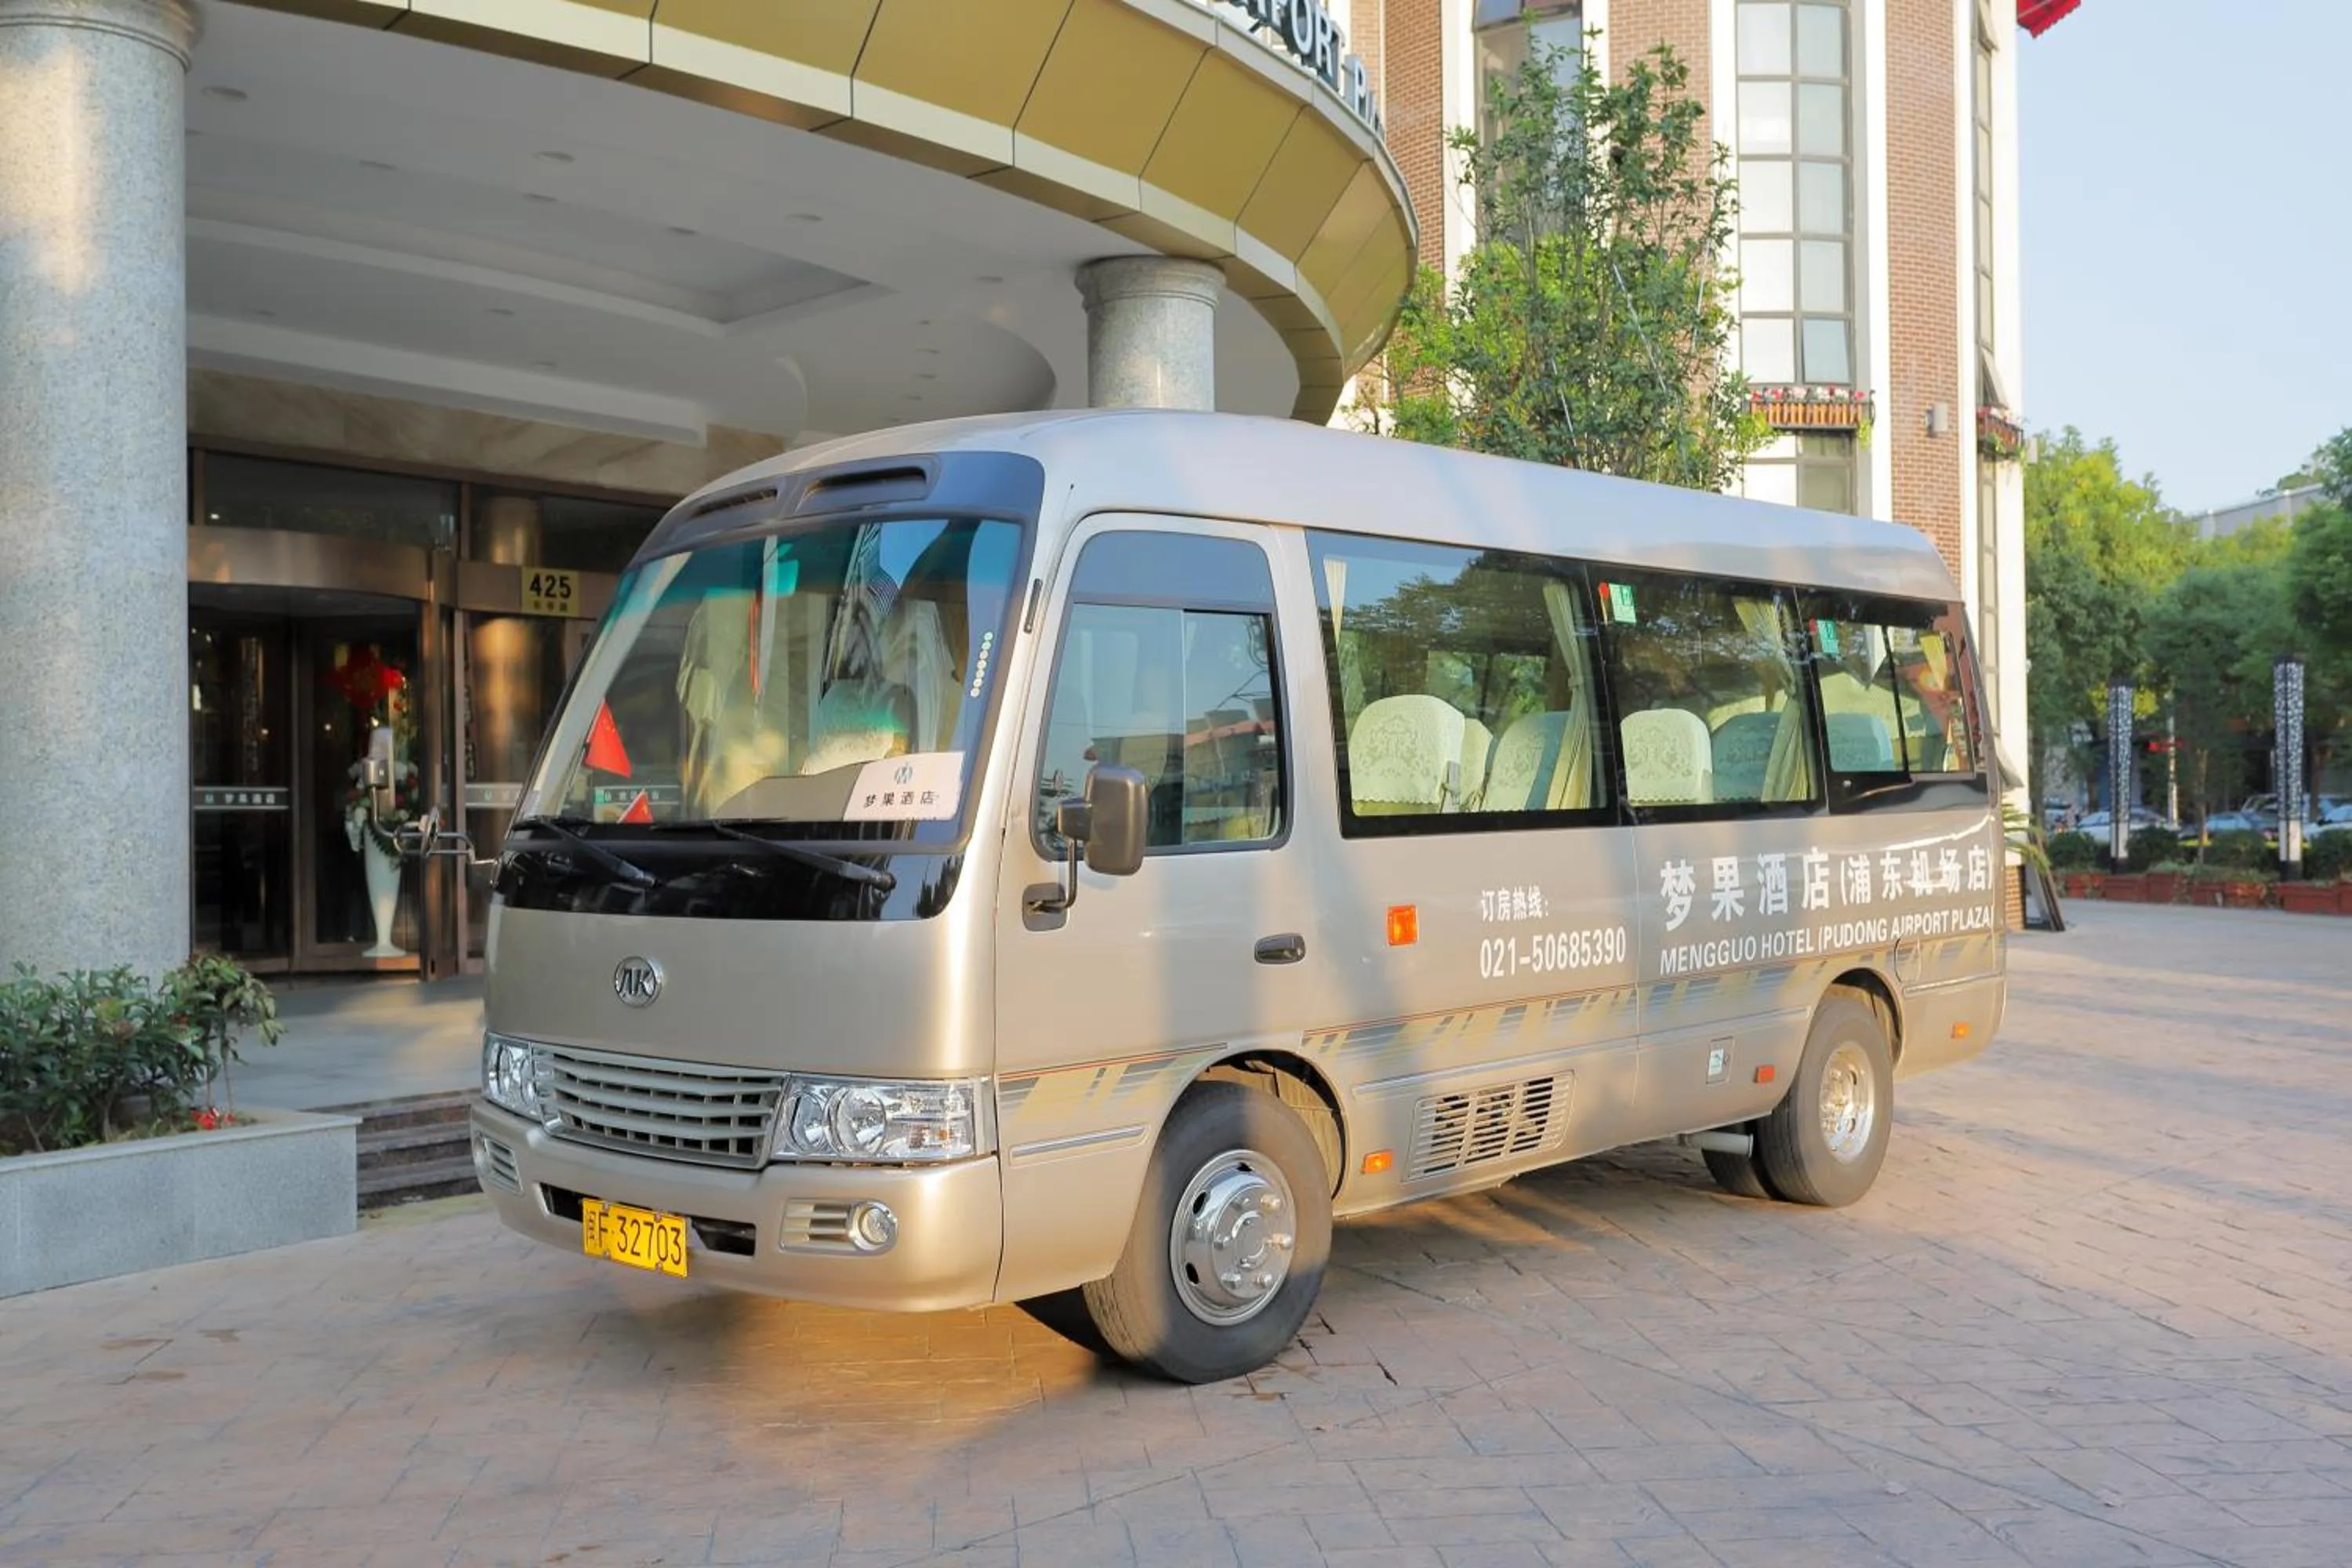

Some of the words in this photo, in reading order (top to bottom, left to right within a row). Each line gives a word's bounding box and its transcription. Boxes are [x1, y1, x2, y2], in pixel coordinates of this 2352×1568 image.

[530, 573, 571, 598] 425
[1480, 926, 1626, 978] 021-50685390
[1660, 936, 1757, 975] MENGGUO
[1762, 928, 1814, 959] HOTEL
[1818, 917, 1887, 953] (PUDONG
[1890, 910, 1949, 939] AIRPORT
